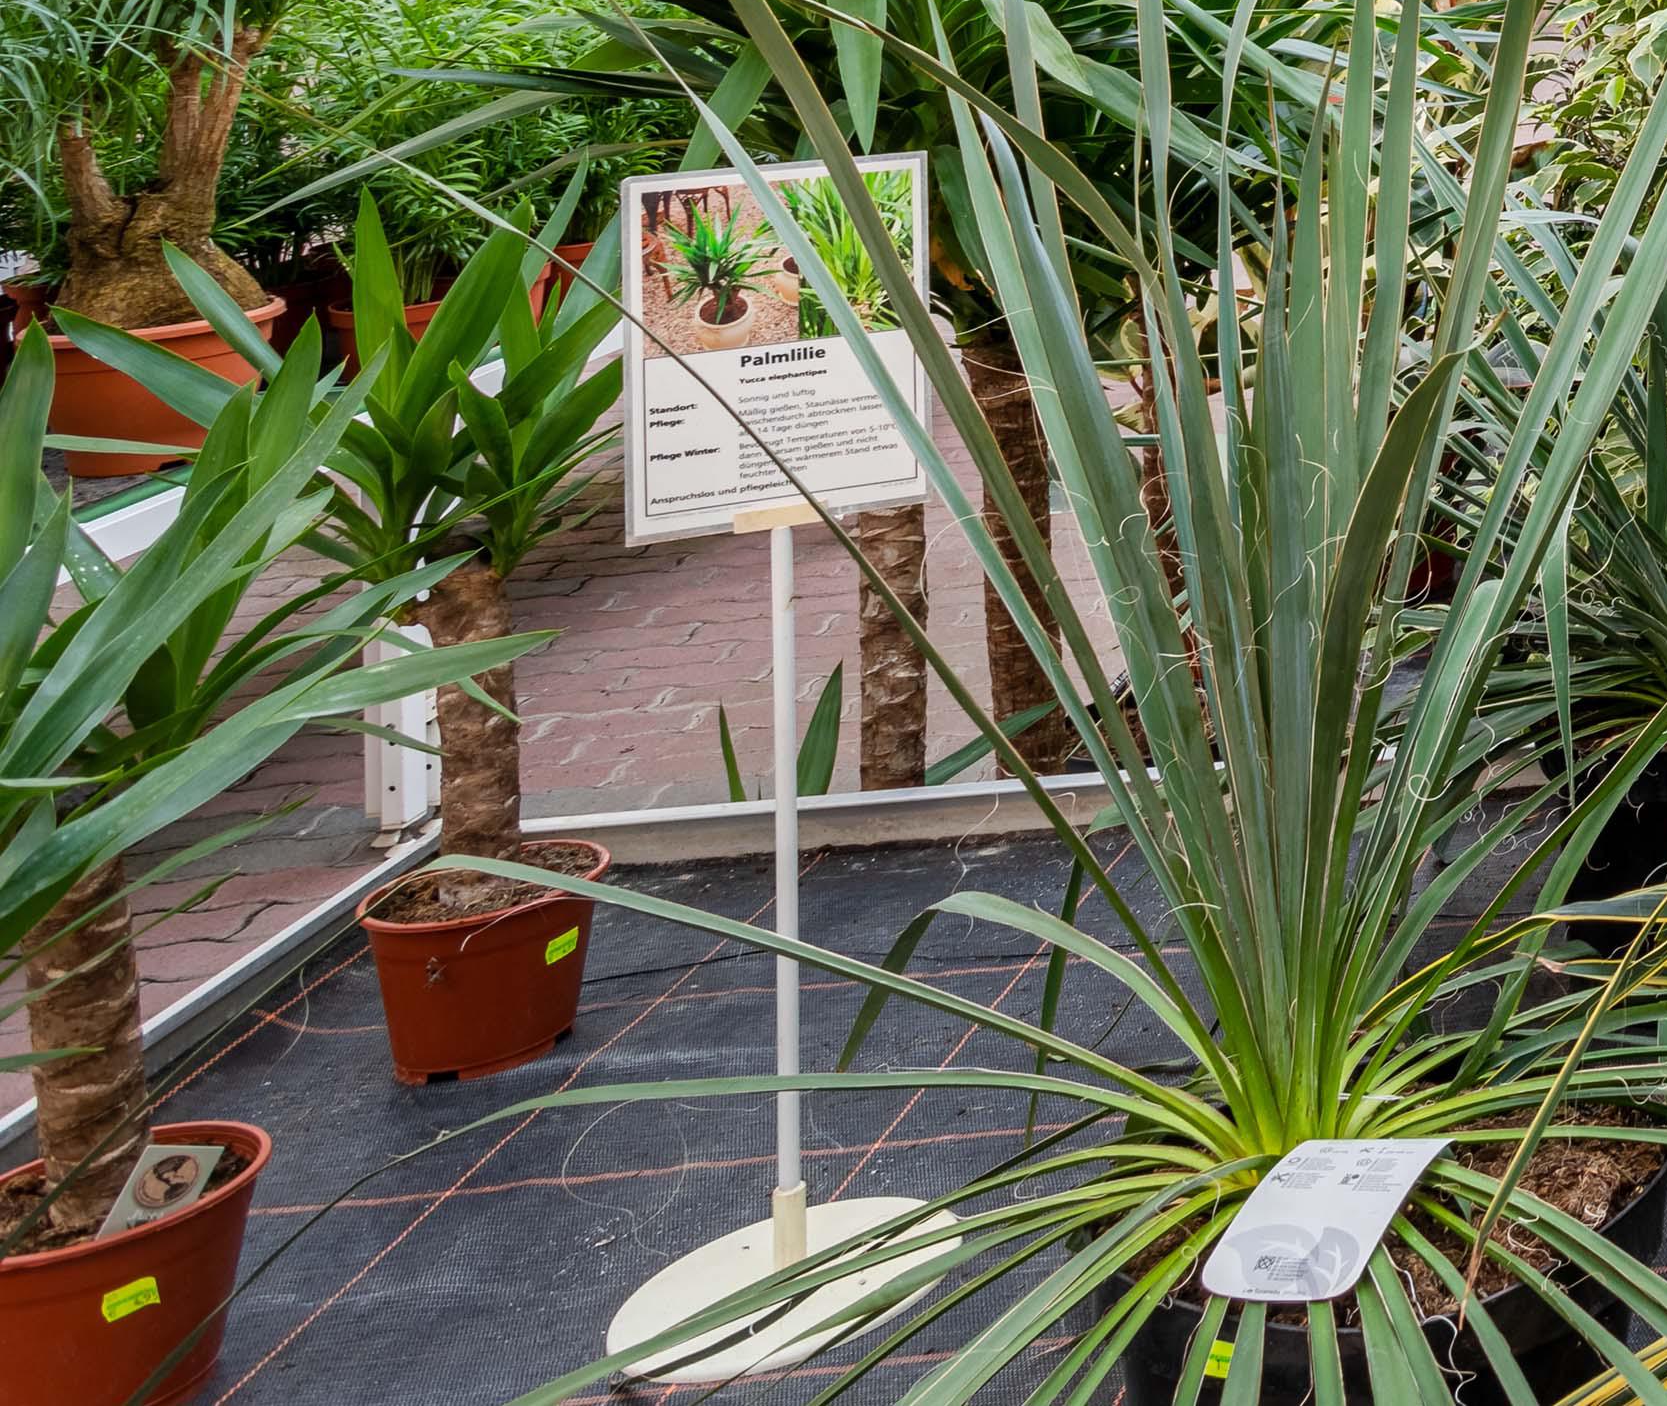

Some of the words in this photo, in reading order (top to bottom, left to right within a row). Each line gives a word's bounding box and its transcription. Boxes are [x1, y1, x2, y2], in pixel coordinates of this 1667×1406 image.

[740, 346, 826, 368] Palmlilie
[739, 375, 765, 385] Yucca
[768, 368, 828, 382] elephantipes
[738, 394, 769, 405] Sonnig
[772, 390, 790, 400] und
[792, 388, 816, 398] luftig
[649, 402, 699, 416] Standort:
[649, 418, 685, 429] Pflege:
[771, 424, 793, 434] Tage
[794, 418, 829, 430] düngen
[850, 426, 866, 435] von
[649, 452, 682, 463] Pflege
[685, 447, 721, 459] Winter:
[738, 450, 763, 460] dann
[836, 438, 854, 447] und
[856, 435, 878, 444] nicht
[844, 446, 871, 456] Stand
[872, 442, 899, 452] etwas
[739, 467, 777, 480] feuchter
[651, 490, 715, 506] Anspruchslos
[718, 486, 737, 496] und
[740, 478, 794, 494] pflegeleich
